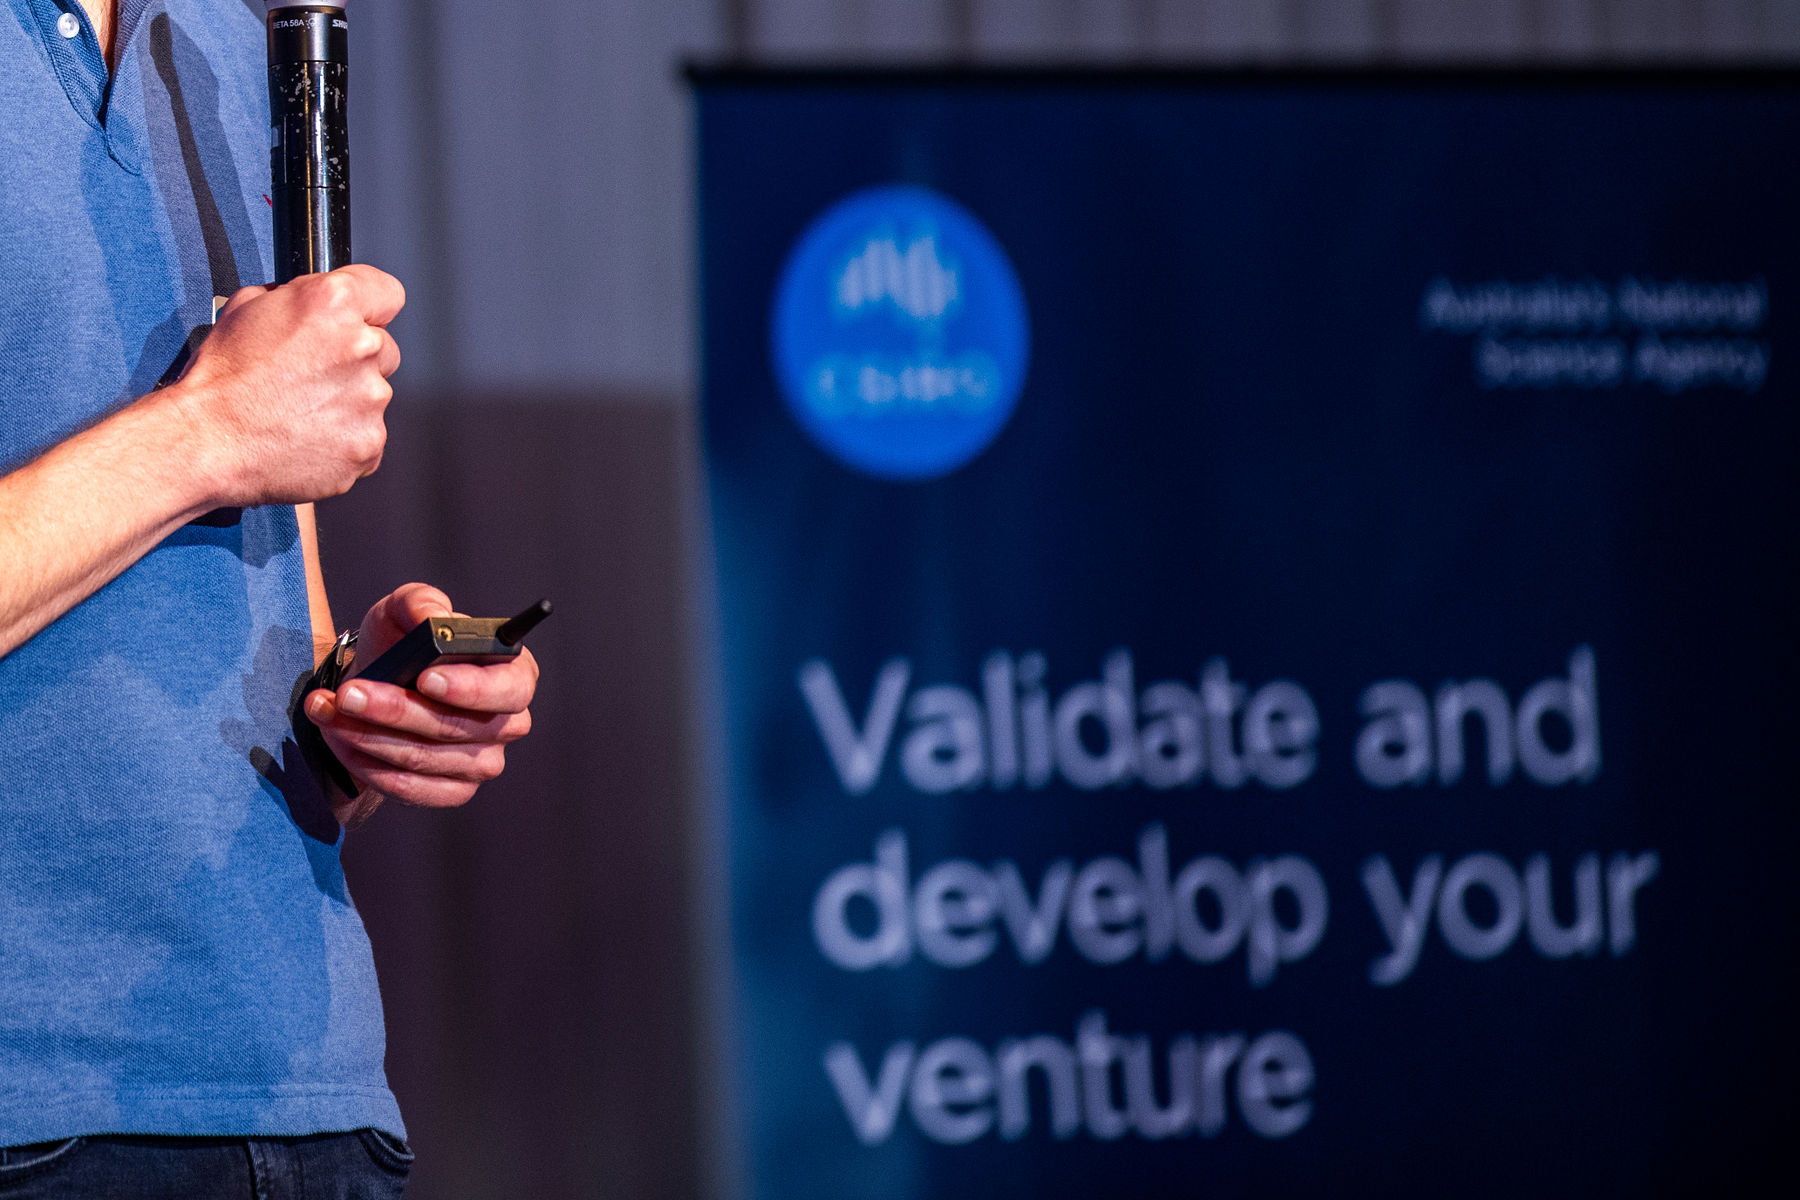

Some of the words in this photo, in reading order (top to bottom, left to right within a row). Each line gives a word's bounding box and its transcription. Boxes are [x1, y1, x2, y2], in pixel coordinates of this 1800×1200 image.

[273, 20, 288, 29] BETA
[289, 19, 304, 27] 58A
[1619, 277, 1765, 328] National
[1480, 339, 1623, 386] Science
[1636, 339, 1767, 393] Agency
[800, 650, 1320, 792] Validate
[1354, 645, 1600, 790] and
[812, 826, 1330, 984] develop
[1362, 852, 1659, 984] your
[824, 1010, 1316, 1145] venture
